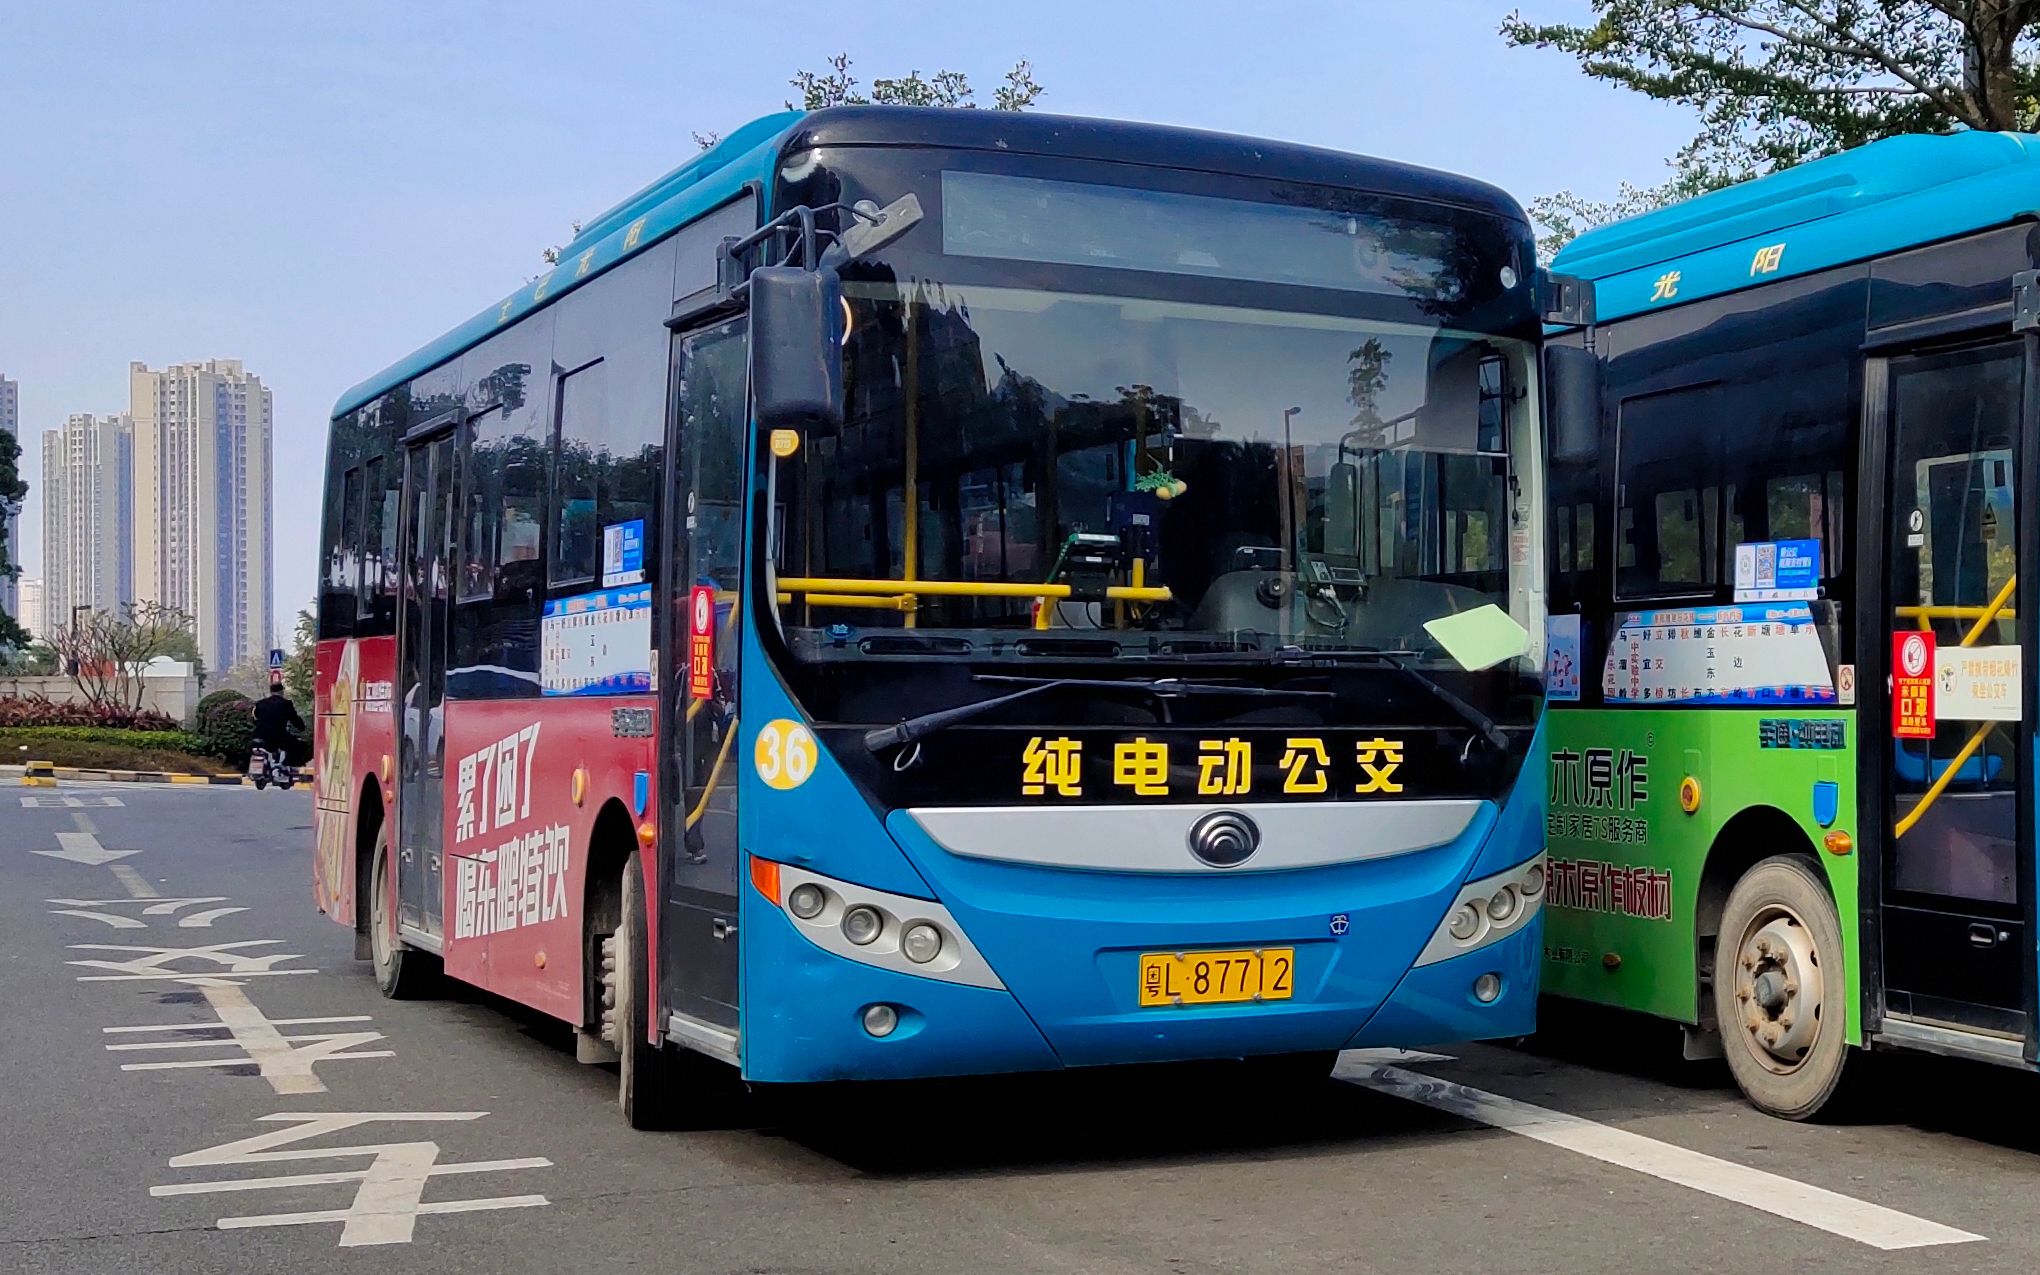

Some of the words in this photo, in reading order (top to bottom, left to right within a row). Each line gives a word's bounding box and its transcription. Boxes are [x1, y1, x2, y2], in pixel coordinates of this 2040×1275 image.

[456, 721, 541, 843] 累了困了
[762, 727, 807, 781] 36
[1022, 737, 1403, 796] 纯电动公交
[1551, 748, 1649, 810] 木原作
[455, 821, 570, 939] 喝东鹏特饮
